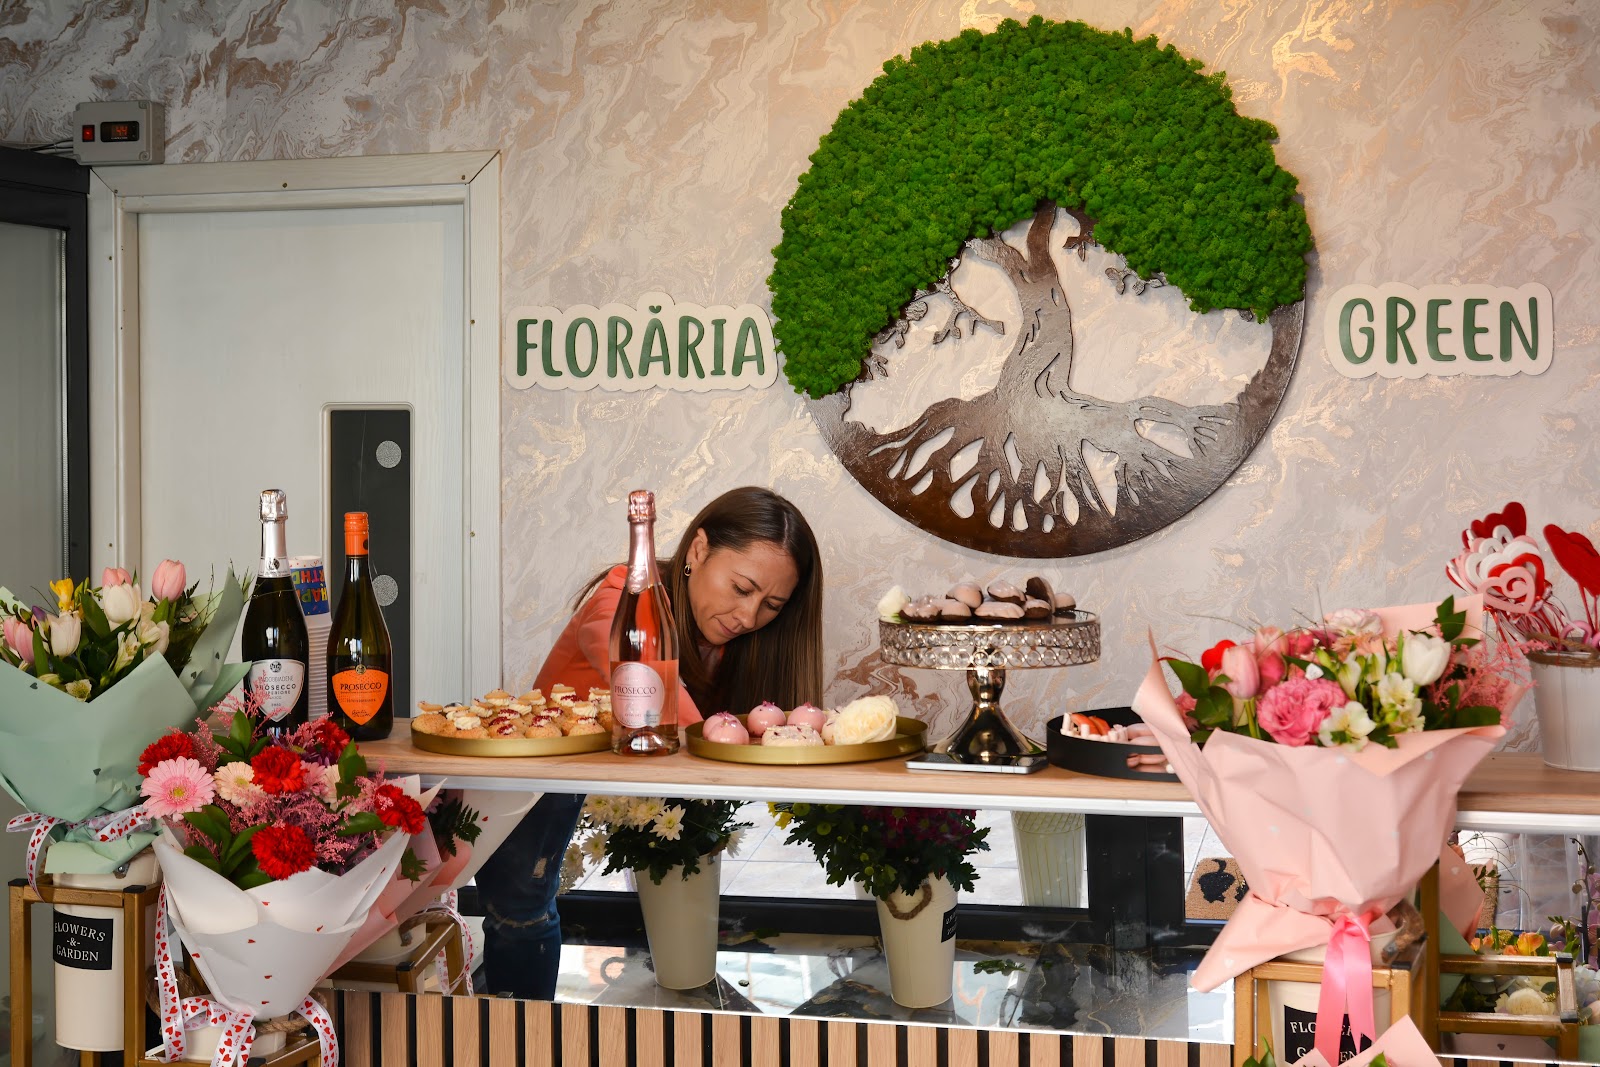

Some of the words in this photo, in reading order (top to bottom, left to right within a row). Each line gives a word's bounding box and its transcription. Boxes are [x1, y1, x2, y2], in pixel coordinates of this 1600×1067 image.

[1338, 296, 1538, 365] GREEN
[516, 304, 766, 380] FLORĂRIA
[340, 681, 382, 691] PROSECCO
[614, 685, 657, 695] PROSECCO
[54, 922, 106, 942] FLOWERS
[56, 944, 99, 962] GARDEN
